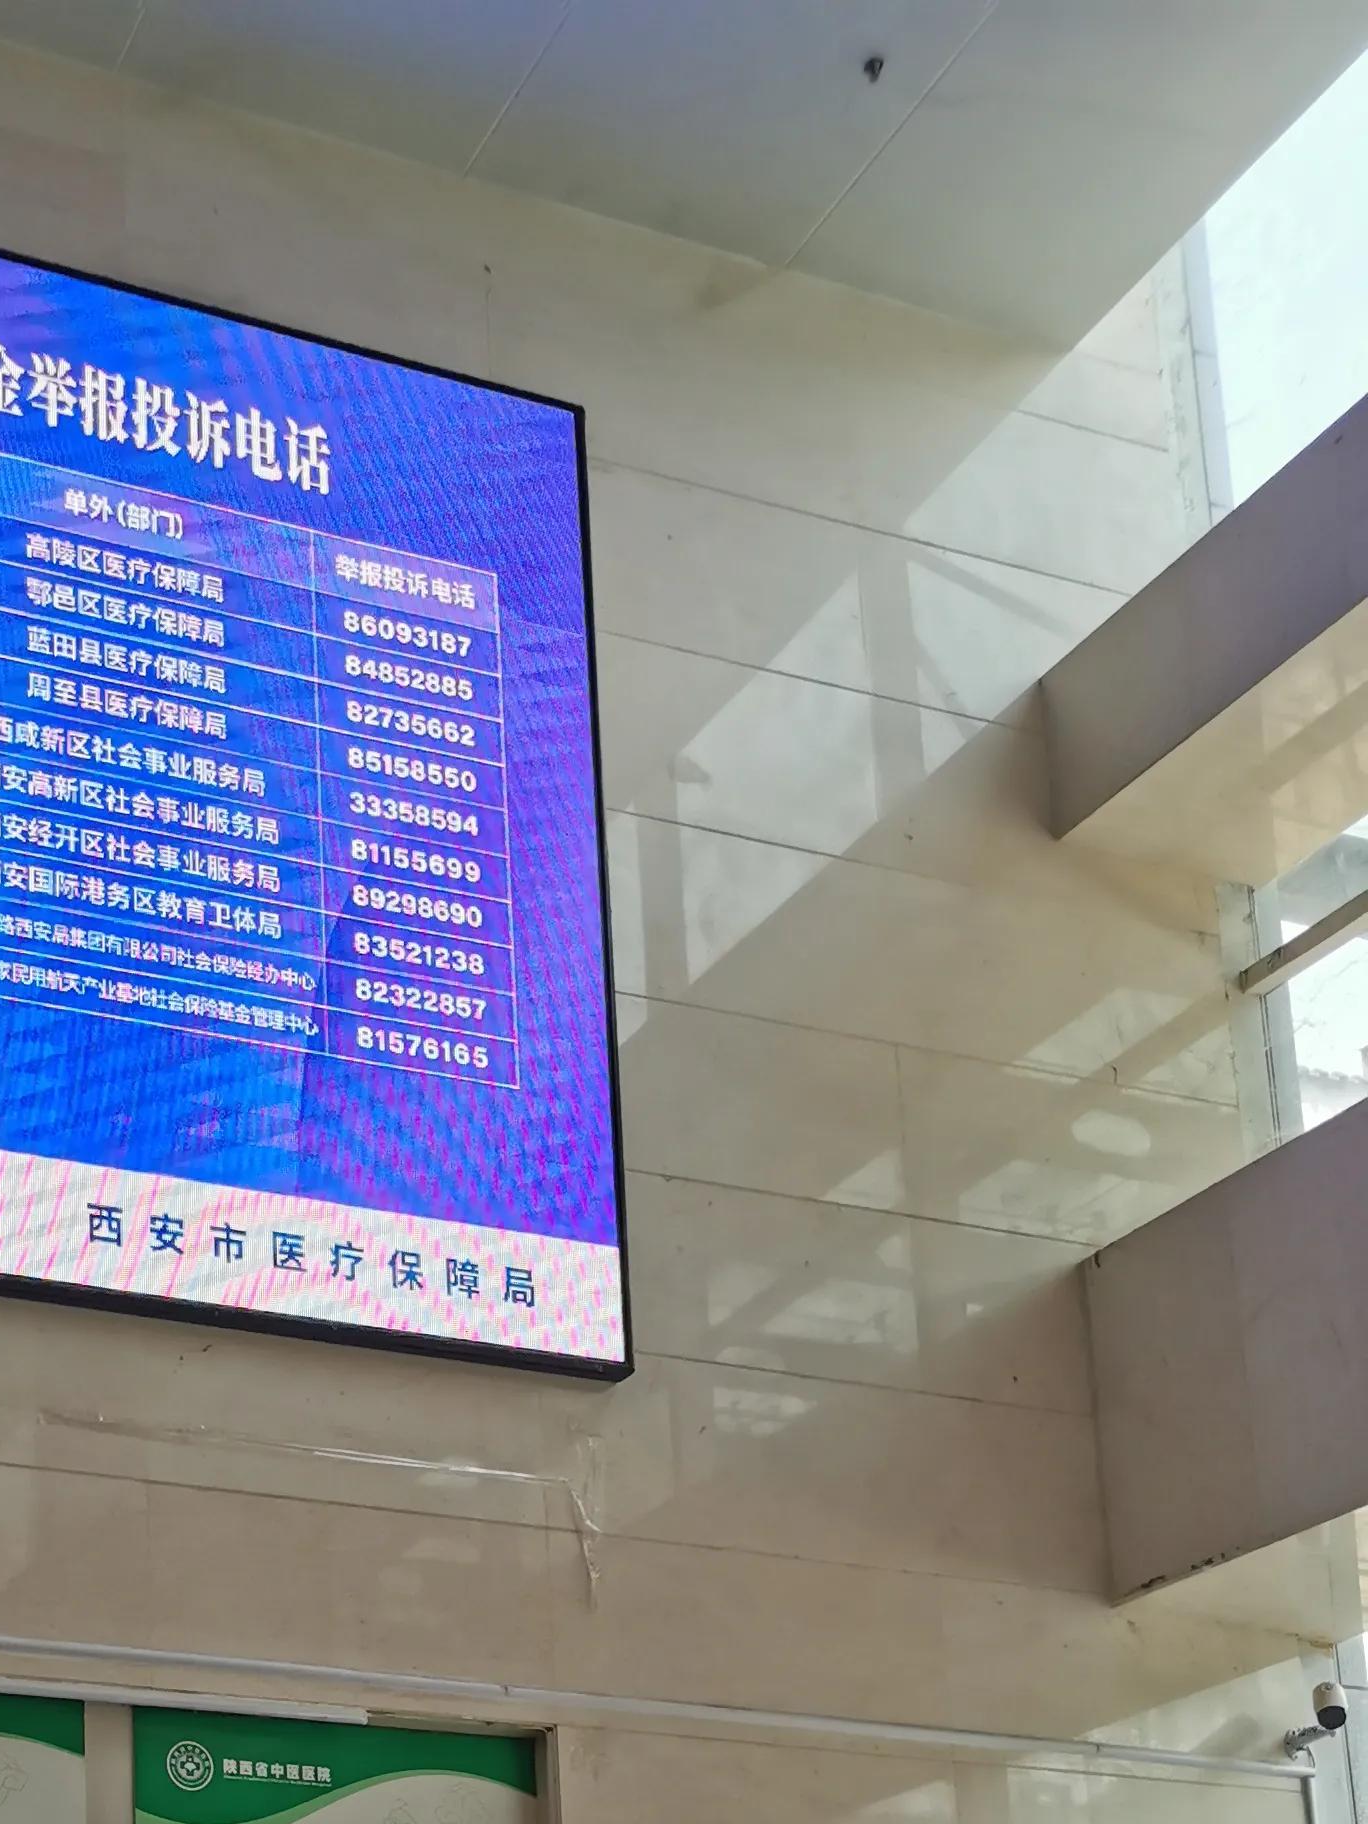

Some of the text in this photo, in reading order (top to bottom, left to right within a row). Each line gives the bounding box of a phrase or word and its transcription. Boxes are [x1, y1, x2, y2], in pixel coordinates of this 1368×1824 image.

[26, 532, 224, 604] 高陵区医疗保障局
[335, 553, 475, 611] 举报投诉电话
[343, 610, 472, 657] 86093187
[27, 625, 226, 695] 蓝田县医疗保障局
[345, 655, 473, 701] 84852885
[27, 671, 227, 740] 周至县医疗保障局
[346, 701, 475, 746] 82735662
[348, 748, 477, 792] 85158550
[349, 790, 479, 838] 33358594
[351, 838, 481, 883] 81155699
[352, 884, 483, 929] 89298690
[353, 930, 485, 976] 83521238
[355, 977, 487, 1022] 82322857
[357, 1025, 489, 1069] 81576165
[87, 1202, 537, 1308] 西安市医疗保障局
[222, 1758, 332, 1783] 陕西省中医医院
